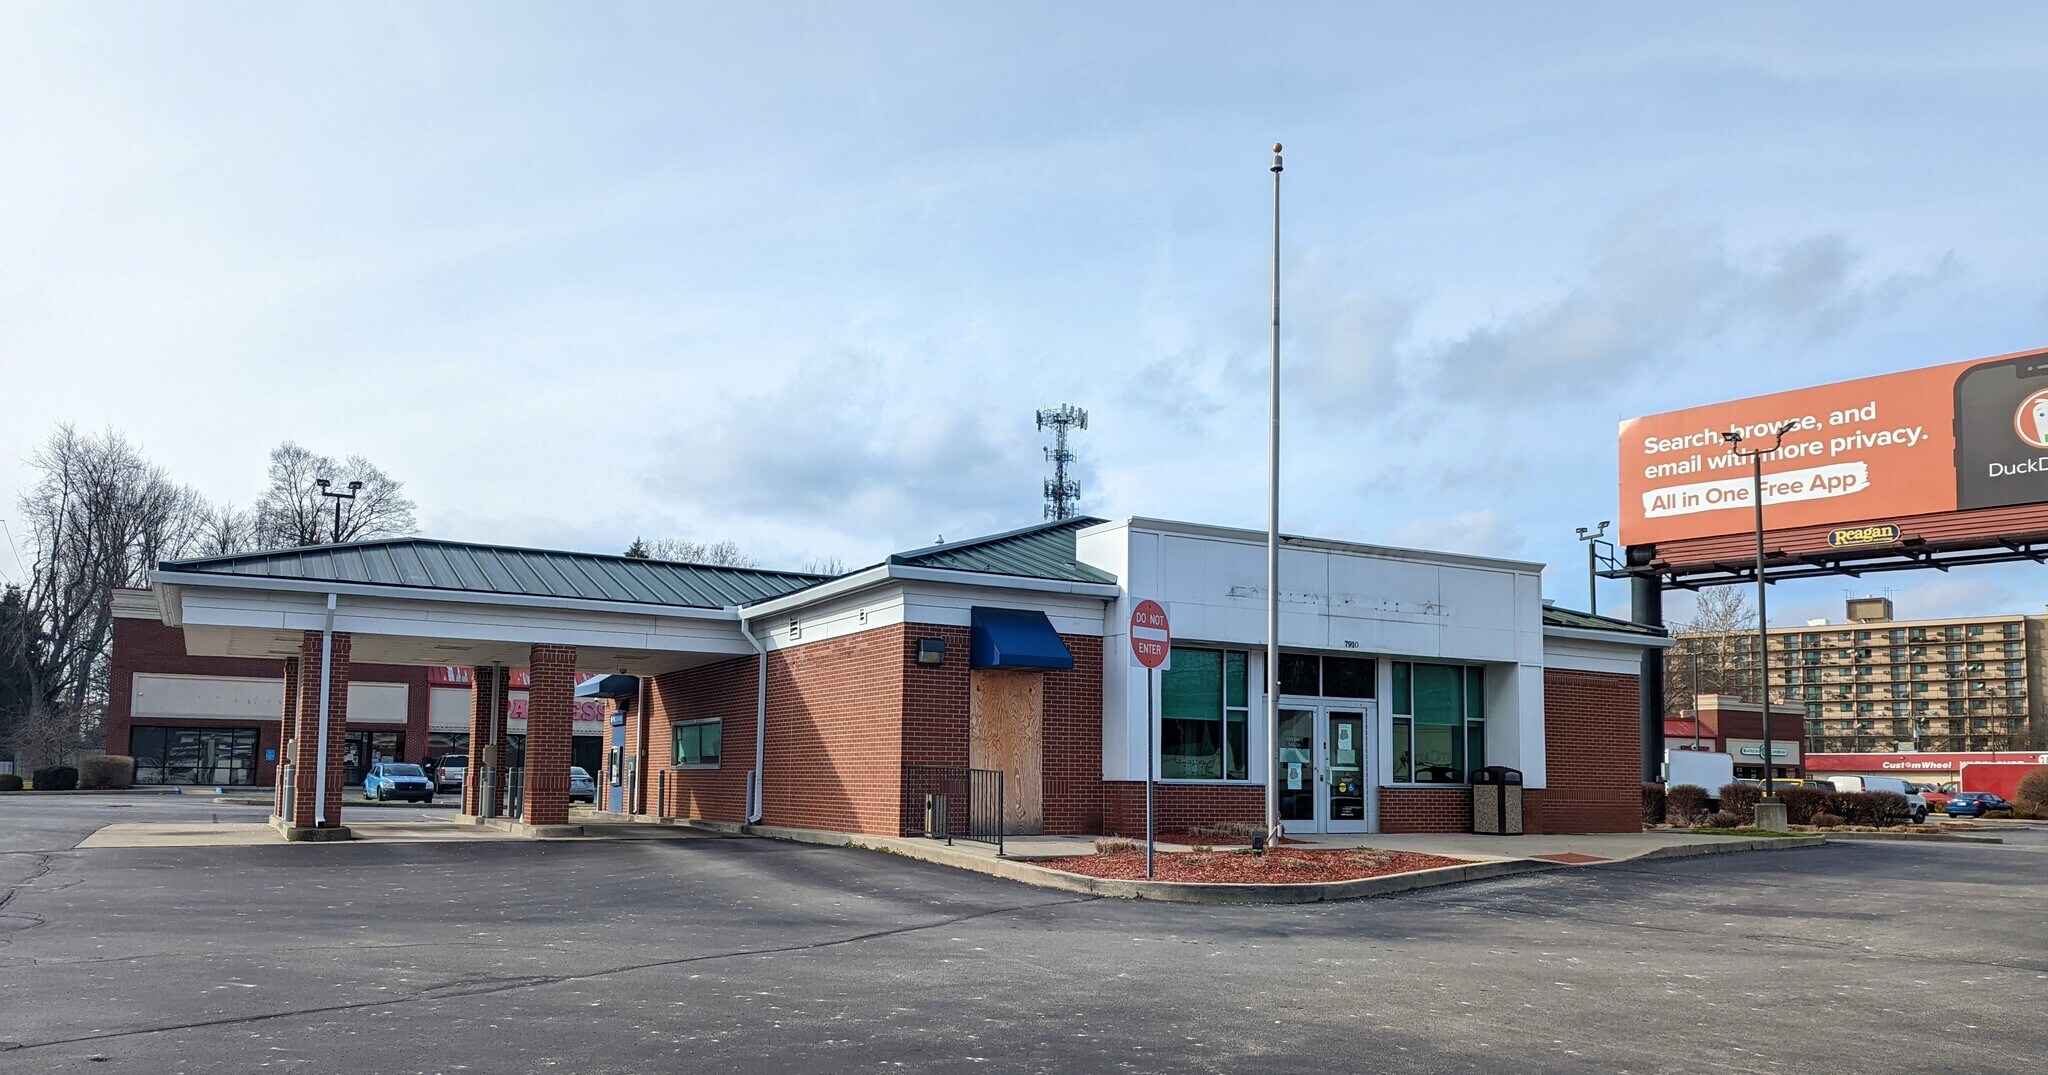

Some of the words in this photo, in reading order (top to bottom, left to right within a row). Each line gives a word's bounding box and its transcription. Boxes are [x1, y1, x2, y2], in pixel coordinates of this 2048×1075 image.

[1643, 427, 1725, 455] Search,
[1829, 401, 1877, 426] and
[1644, 454, 1702, 479] email
[1708, 449, 1757, 471] with
[1760, 438, 1823, 462] more
[1830, 425, 1929, 456] privacy.
[1651, 493, 1677, 512] All
[1682, 491, 1700, 508] in
[1705, 484, 1750, 504] One
[1759, 476, 1804, 497] Free
[1809, 471, 1857, 492] App
[1834, 526, 1894, 546] Reagan
[1136, 612, 1146, 623] DO
[1150, 613, 1164, 625] NOT
[1139, 643, 1161, 655] ENTER
[1344, 640, 1359, 648] 7910
